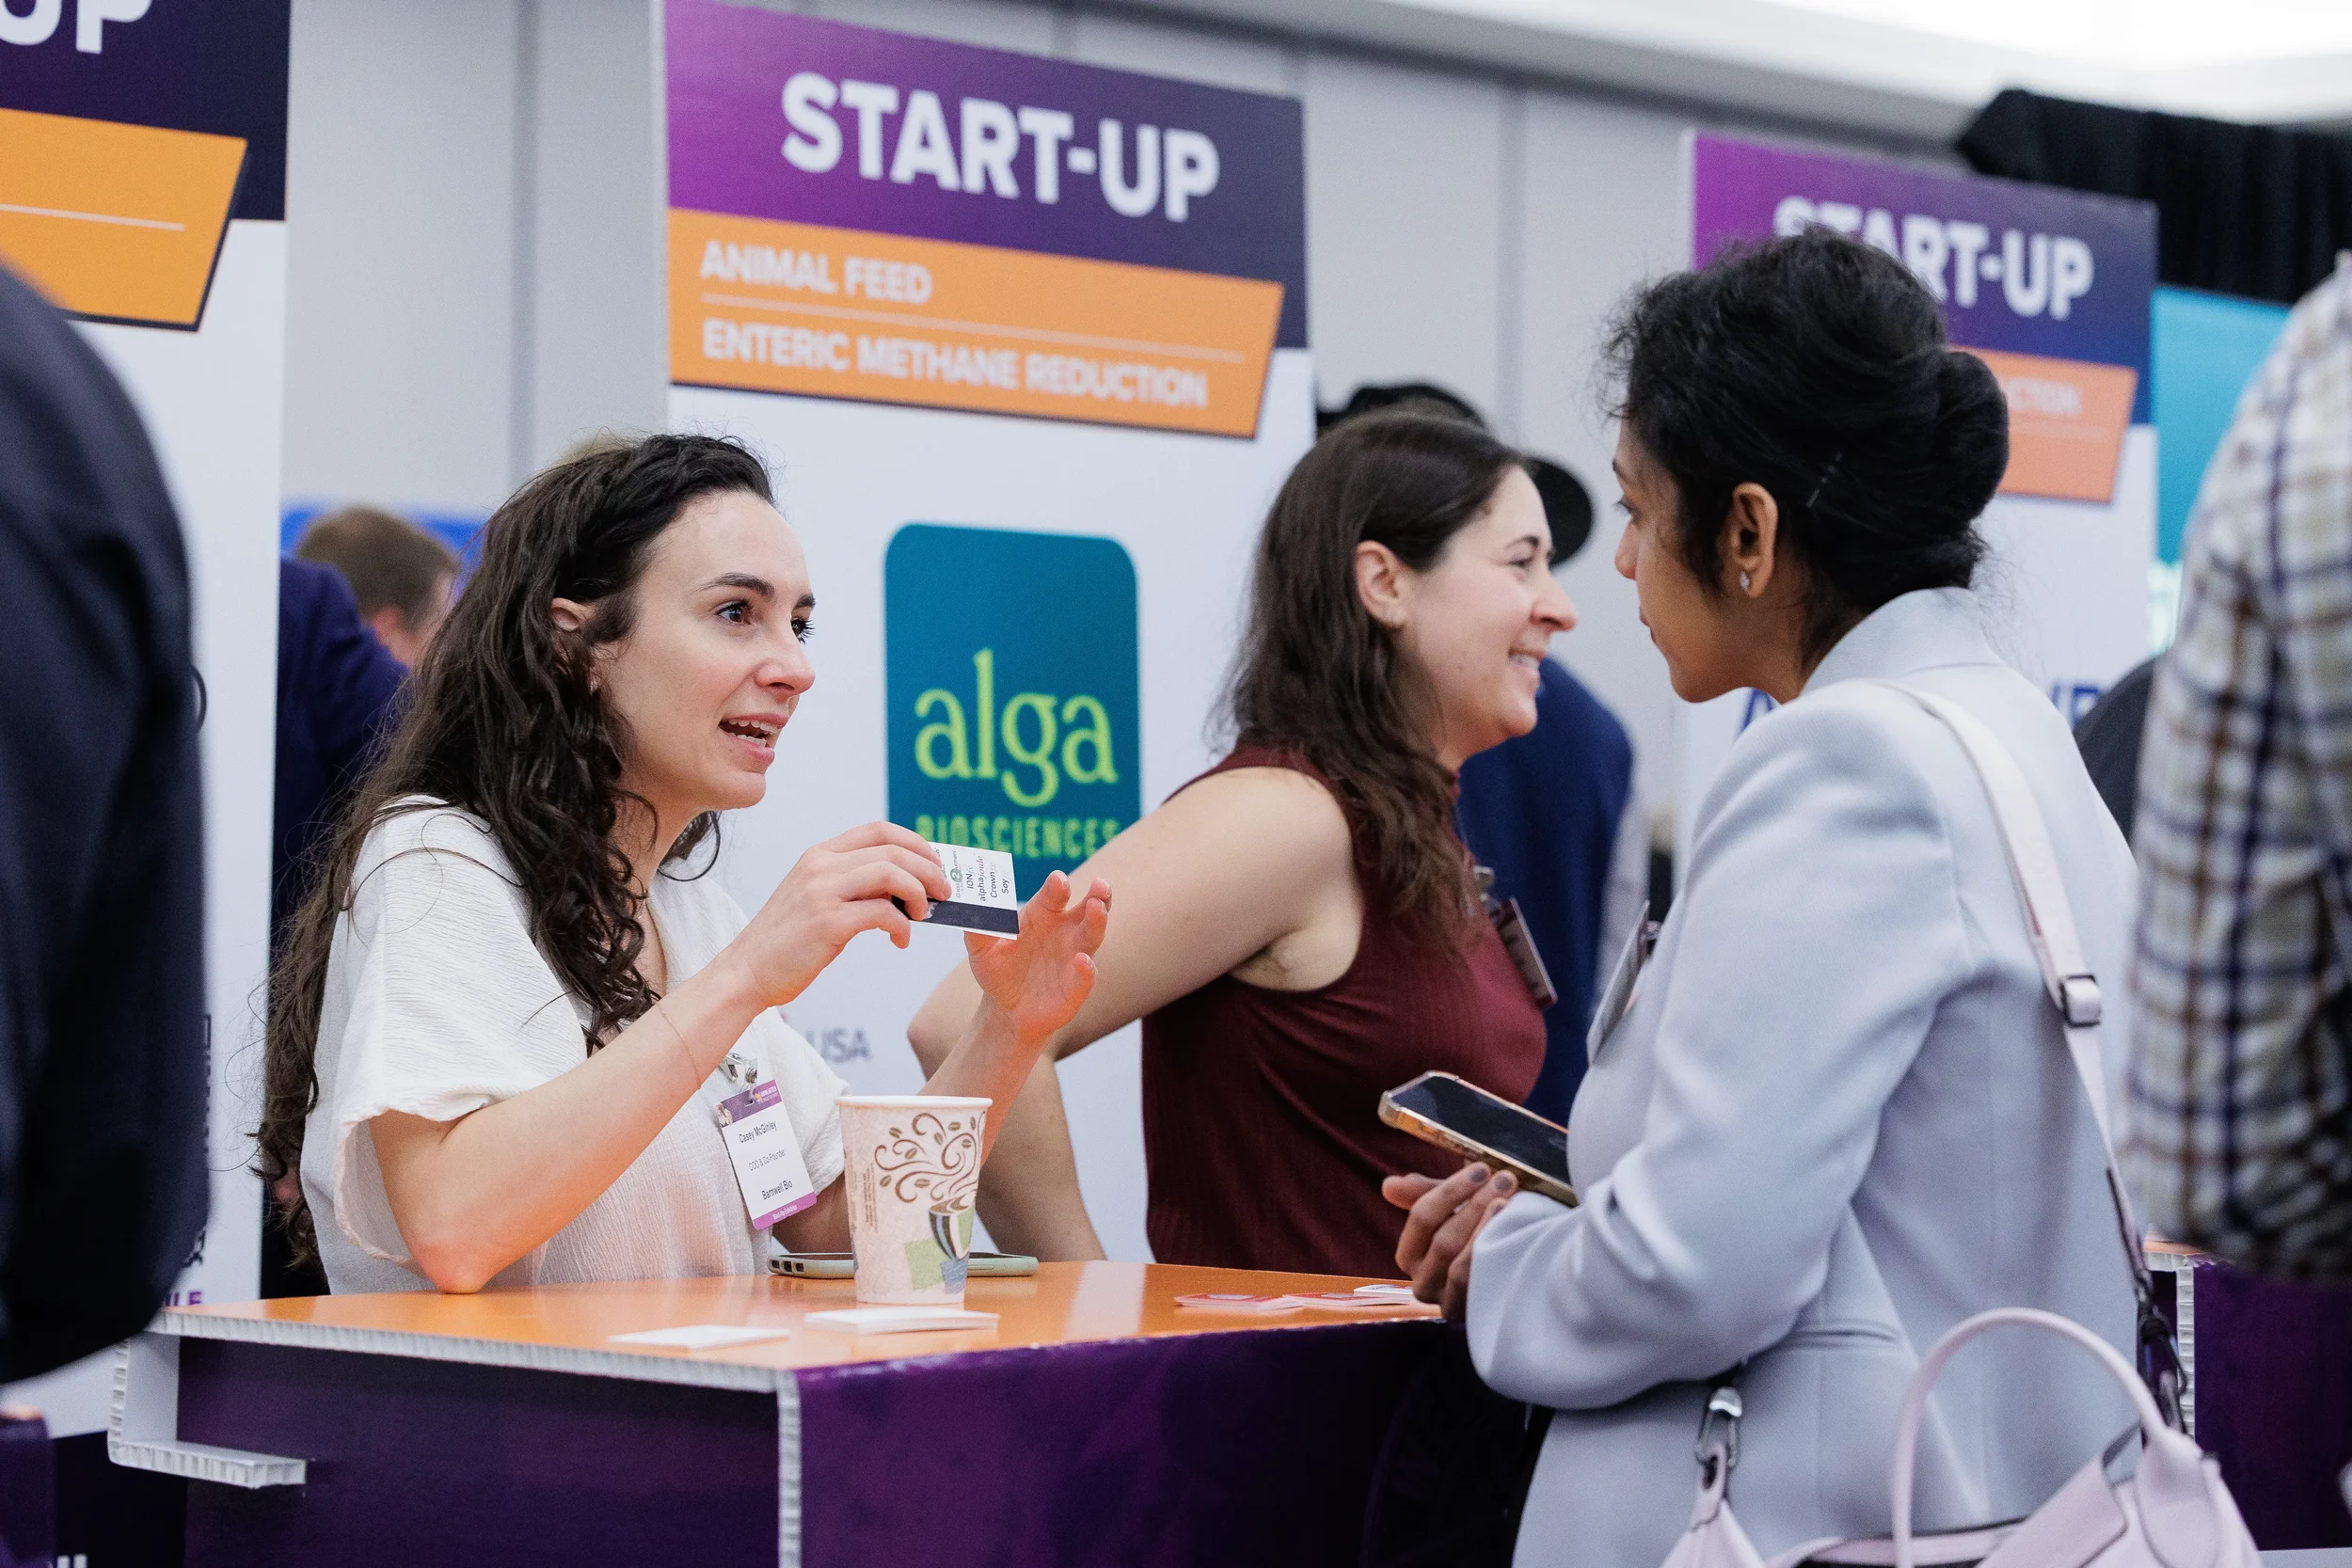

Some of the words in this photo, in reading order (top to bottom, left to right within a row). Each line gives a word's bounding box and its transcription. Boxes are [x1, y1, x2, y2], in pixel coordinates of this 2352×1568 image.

[781, 71, 1220, 222] START-UP
[700, 239, 838, 294] ANIMAL
[844, 256, 933, 305] FEED
[1773, 195, 2094, 321] ART-UP
[702, 318, 850, 373] ENTERIC
[856, 335, 1020, 390] METHANE
[1025, 353, 1209, 408] REDUCTION
[914, 647, 1119, 807] alga
[739, 1131, 755, 1143] Casey
[783, 1179, 793, 1191] Bio
